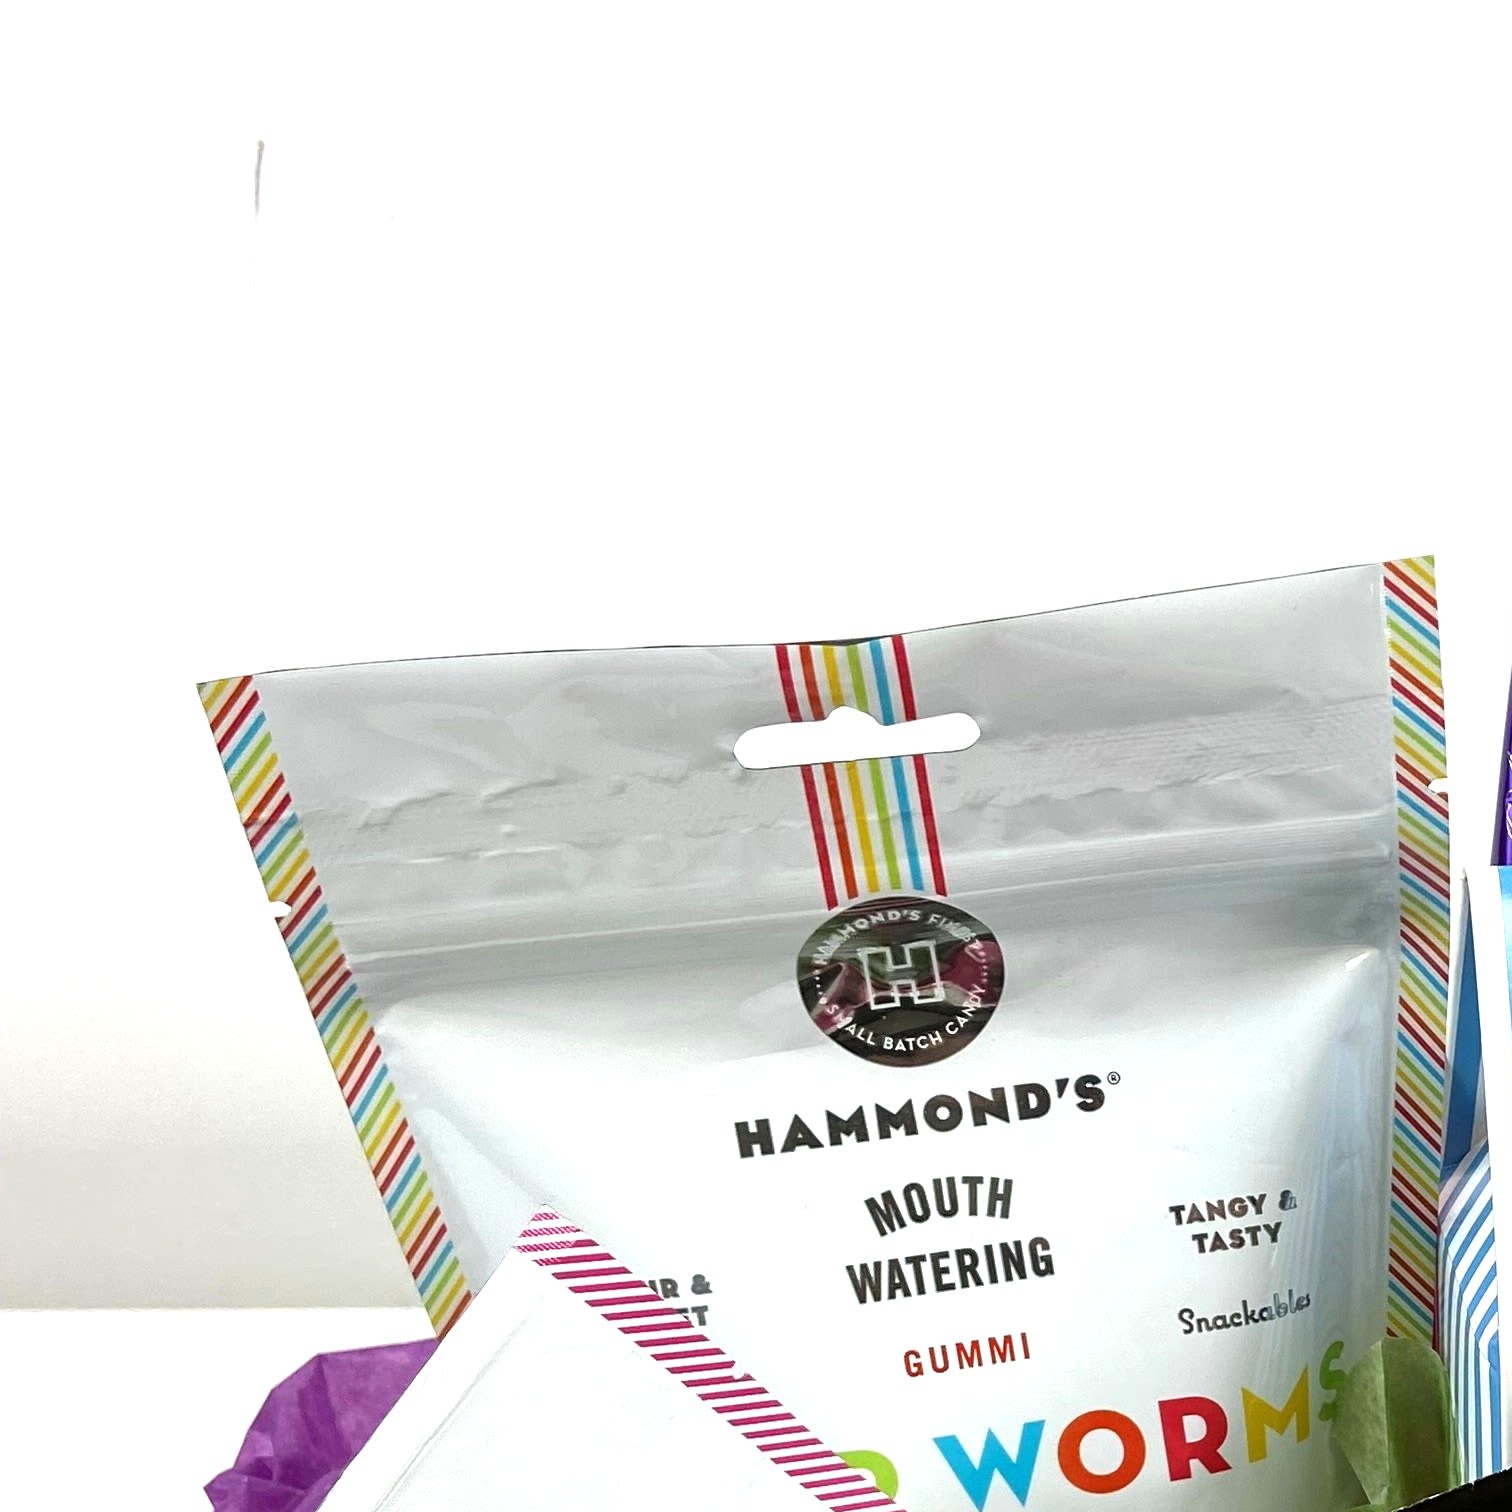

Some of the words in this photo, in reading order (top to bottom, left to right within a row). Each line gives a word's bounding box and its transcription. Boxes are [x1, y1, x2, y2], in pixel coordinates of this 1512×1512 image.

[883, 1029, 943, 1052] BATCH
[945, 983, 986, 1036] CANDY
[864, 1174, 1014, 1237] MOUTH
[1168, 1193, 1267, 1226] TANGY
[1192, 1221, 1282, 1254] TASTY
[845, 1236, 1055, 1305] WATERING
[1178, 1288, 1312, 1335] Snackables
[903, 1332, 1032, 1378] GUMMI
